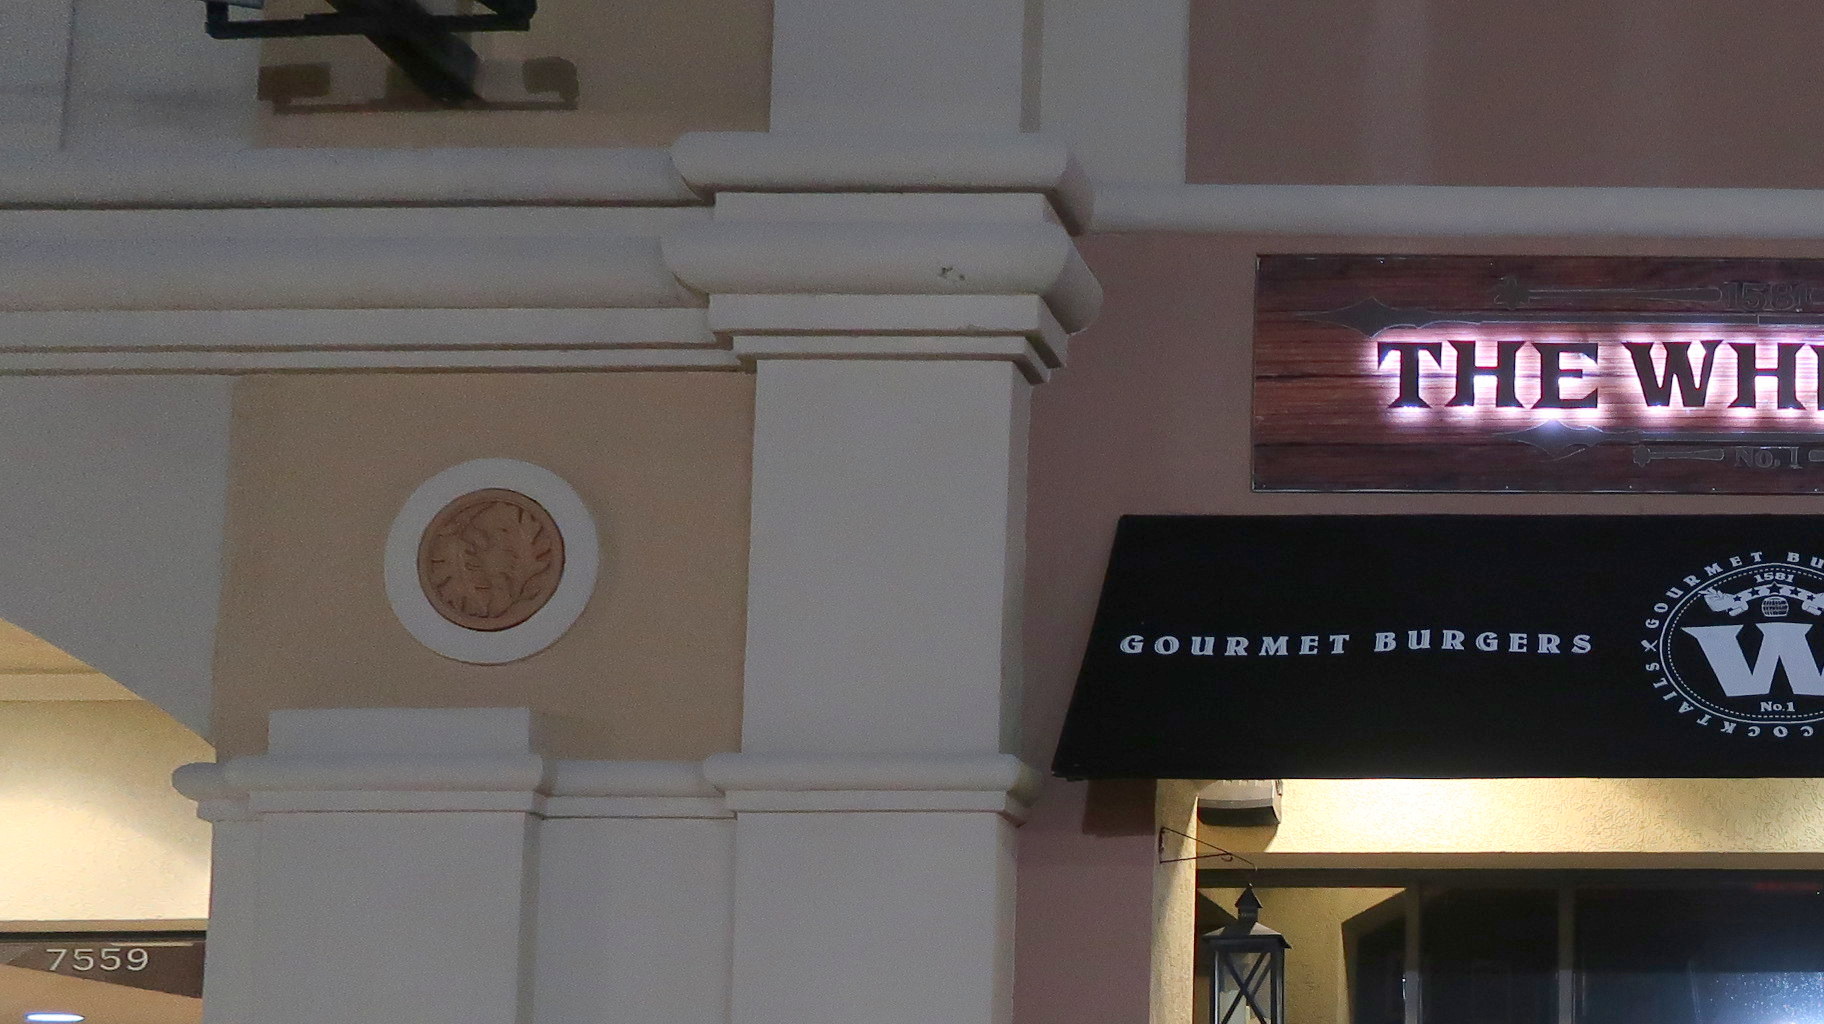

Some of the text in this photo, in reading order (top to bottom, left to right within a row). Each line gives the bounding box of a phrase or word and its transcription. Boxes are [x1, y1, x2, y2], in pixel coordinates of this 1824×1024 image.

[1377, 339, 1599, 409] THE
[1645, 551, 1763, 629] GOURMET
[1753, 572, 1794, 583] 1581
[1119, 629, 1593, 656] GOURMET BURGERS
[1645, 661, 1814, 738] COCKTAILS
[1760, 701, 1796, 712] No.1
[46, 948, 149, 971] 7559
